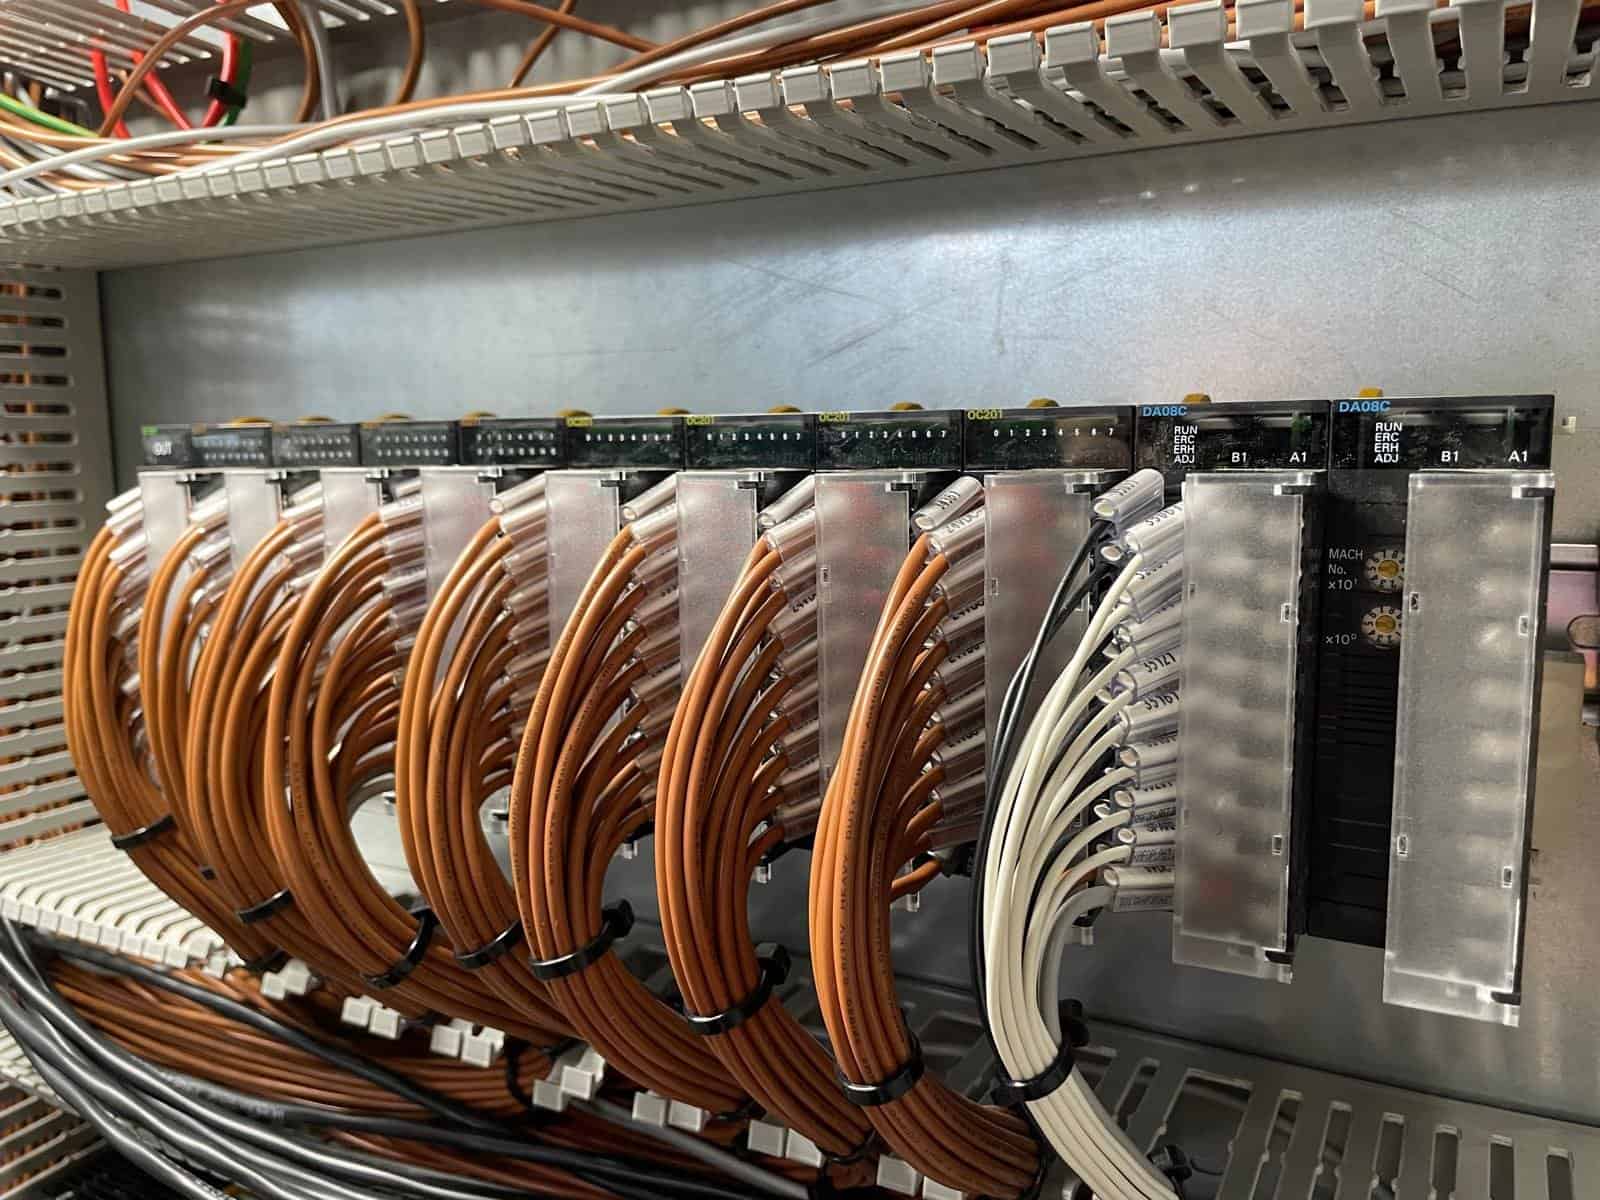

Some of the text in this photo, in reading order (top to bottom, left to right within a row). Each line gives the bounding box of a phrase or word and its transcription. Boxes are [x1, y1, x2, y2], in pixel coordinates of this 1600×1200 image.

[1142, 405, 1187, 417] DA08C
[1339, 400, 1391, 413] DA08C
[967, 409, 1003, 420] OC201
[1174, 425, 1198, 435] RUN
[1375, 422, 1403, 432] RUN
[1174, 435, 1195, 444] ERC
[1375, 432, 1399, 442] ERC
[1173, 445, 1195, 454] ERH
[1374, 443, 1399, 453] ERH
[1174, 454, 1195, 464] ADJ
[1231, 452, 1307, 463] B1 A1
[1374, 453, 1399, 463] ADJ
[1441, 450, 1528, 462] B1 A1
[1329, 548, 1363, 560] MACH
[1328, 563, 1347, 575] No.
